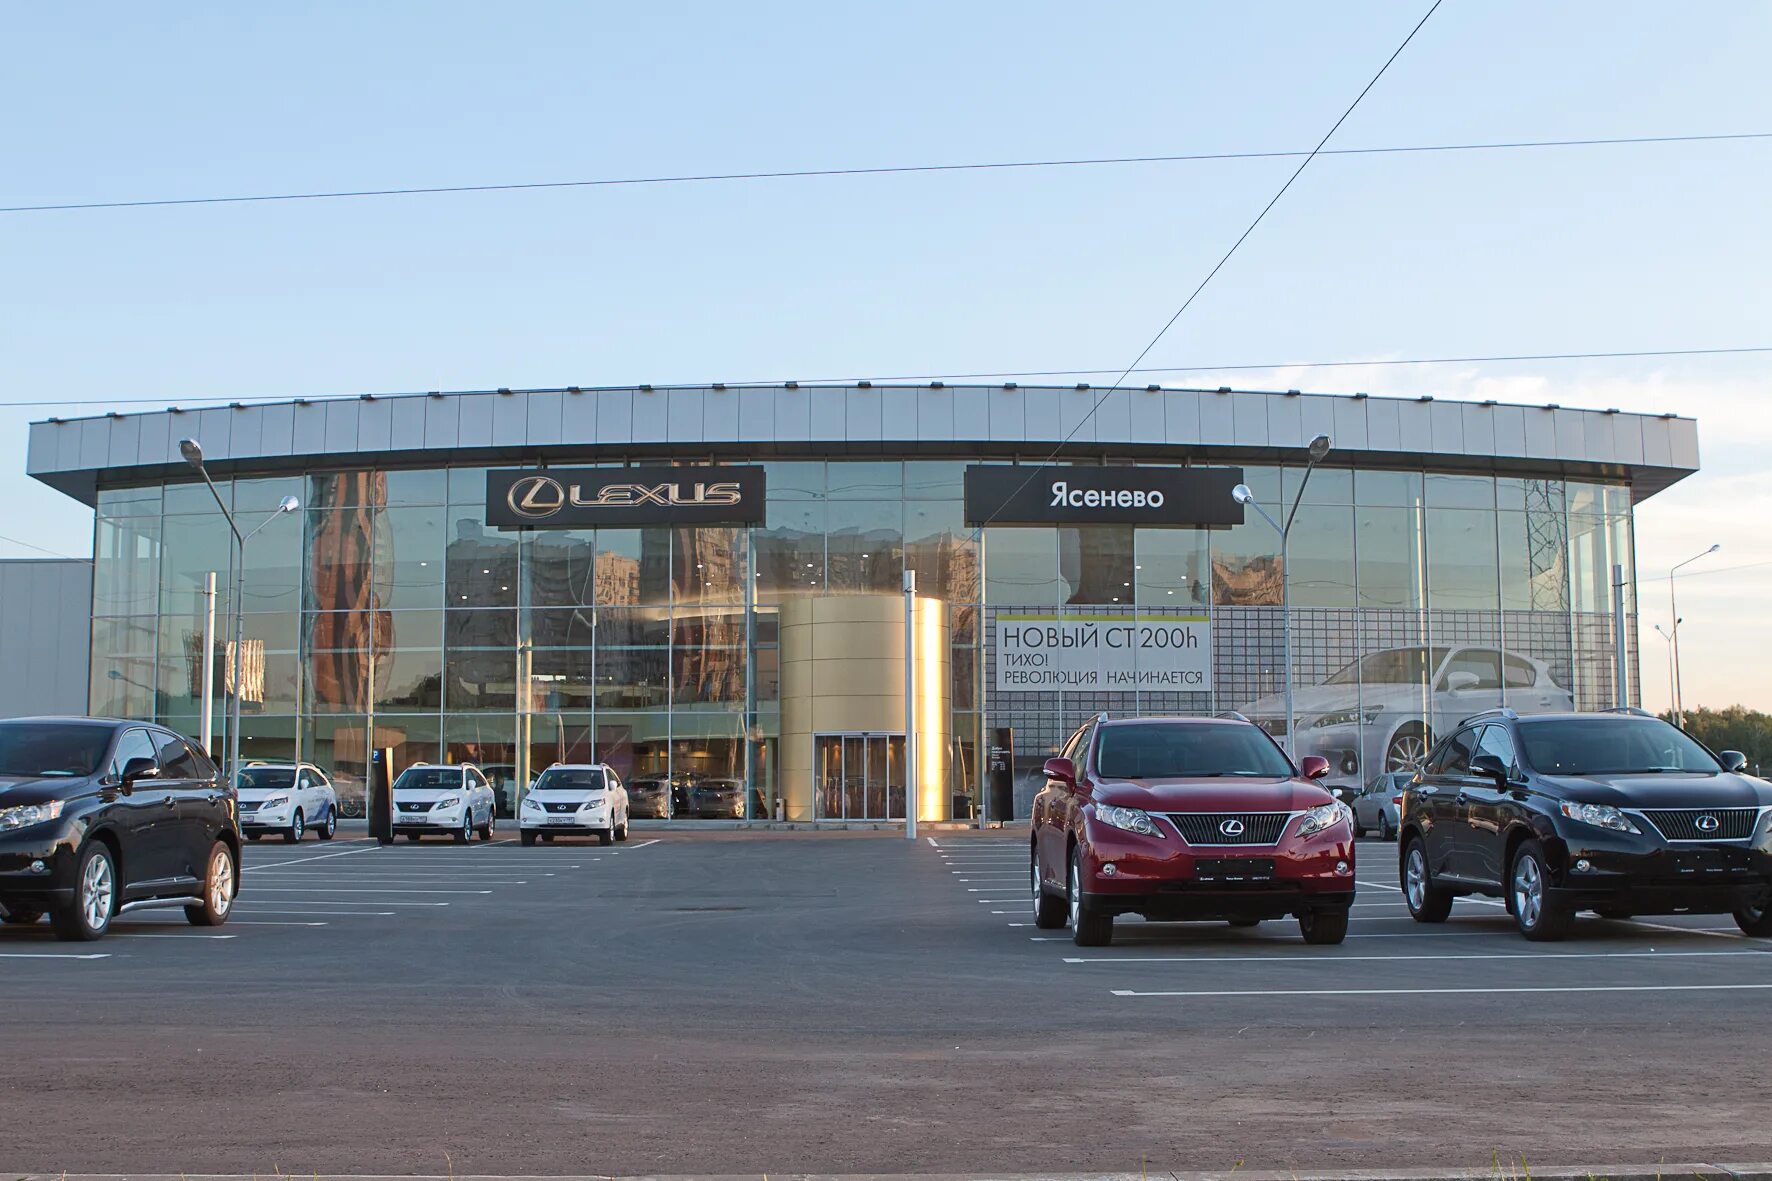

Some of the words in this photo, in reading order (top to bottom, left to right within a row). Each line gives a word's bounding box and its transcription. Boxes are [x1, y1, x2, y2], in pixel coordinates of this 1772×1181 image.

[569, 482, 742, 507] LEXUS
[1050, 481, 1164, 508] Ясенево
[1004, 623, 1098, 648] НОВЫЙ
[1140, 626, 1198, 649] 200h
[1004, 653, 1049, 667] ТИХО!
[1004, 671, 1098, 686] РЕВОЛЮЦИЯ
[1107, 671, 1203, 685] НАЧИНАЕТСЯ
